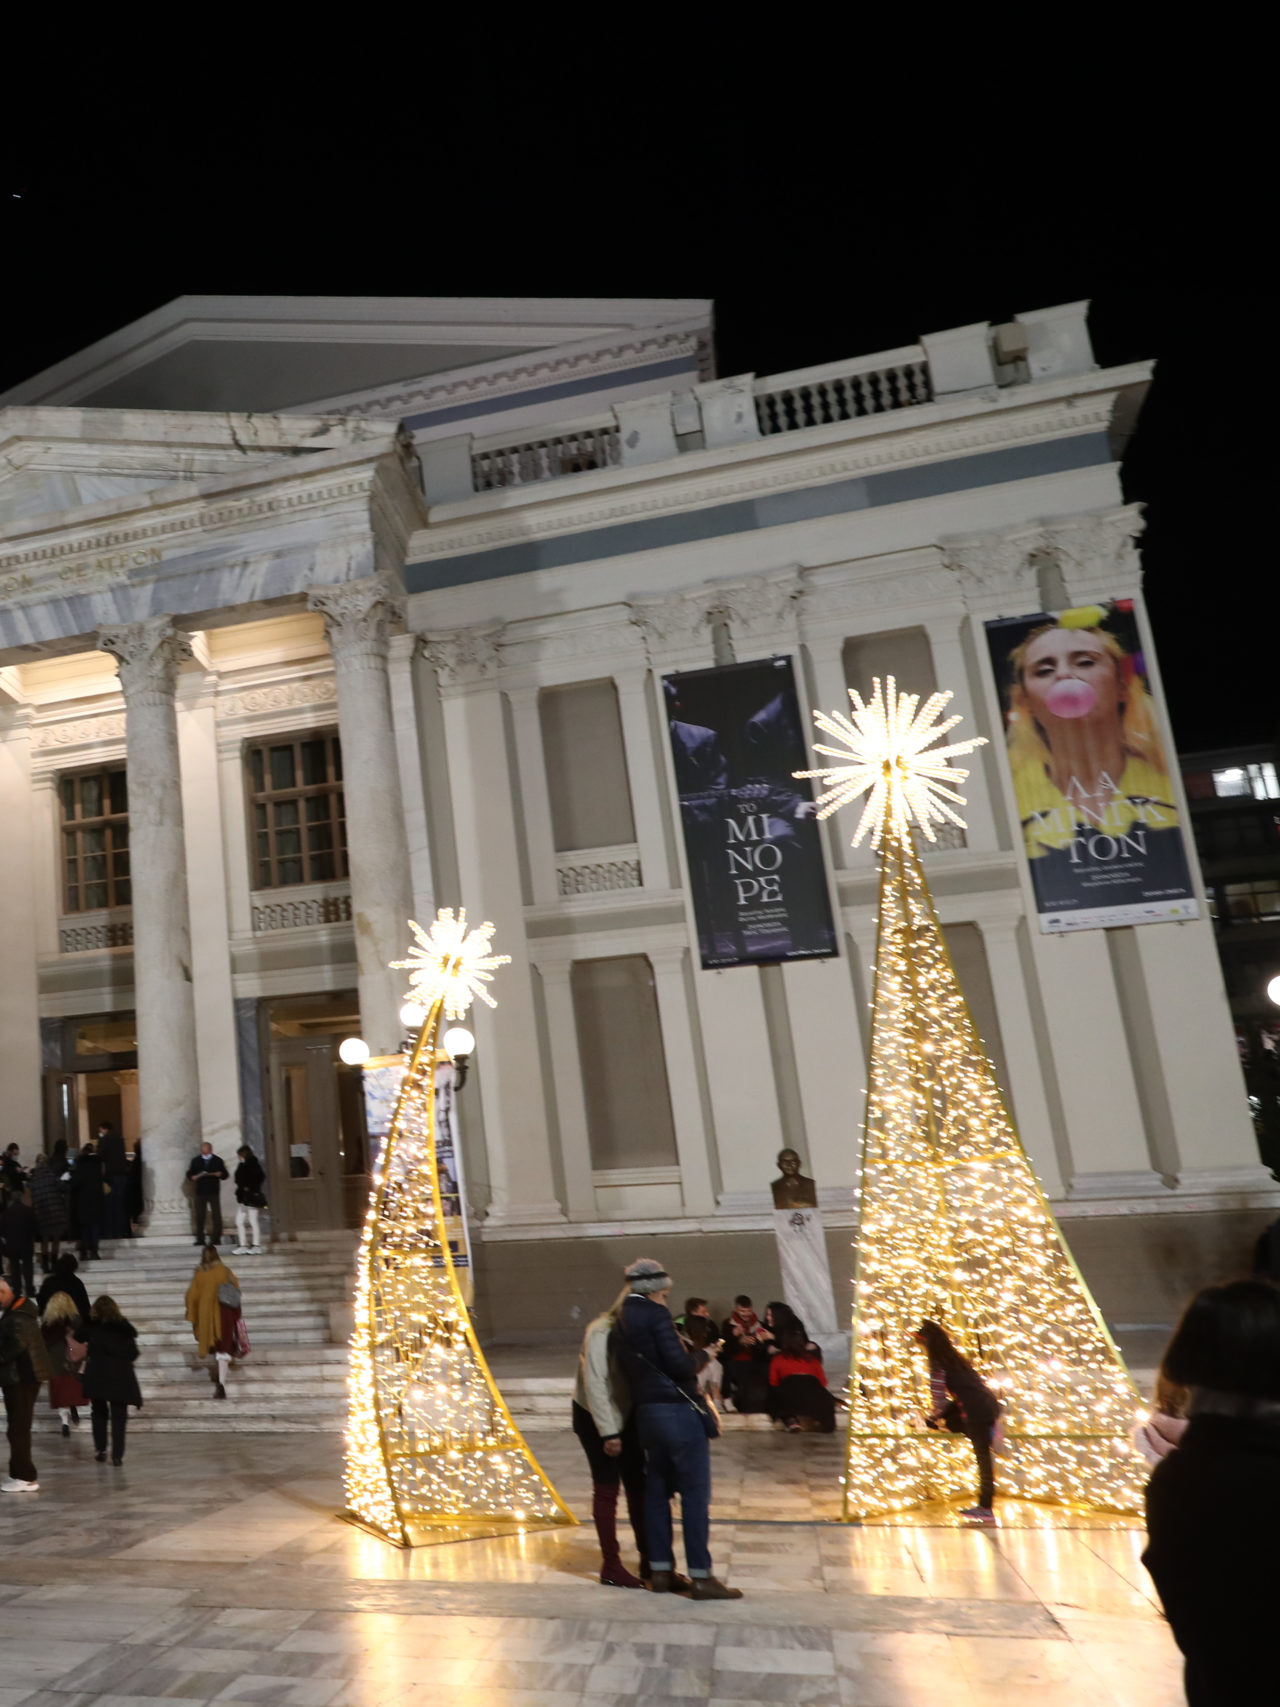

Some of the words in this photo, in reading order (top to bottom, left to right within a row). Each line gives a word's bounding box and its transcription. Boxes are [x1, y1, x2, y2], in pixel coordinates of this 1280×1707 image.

[724, 813, 773, 843] ΜΙ
[725, 844, 782, 874] ΝΟ
[1058, 830, 1147, 863] ΤΟΝ
[733, 875, 783, 905] ΡΕ
